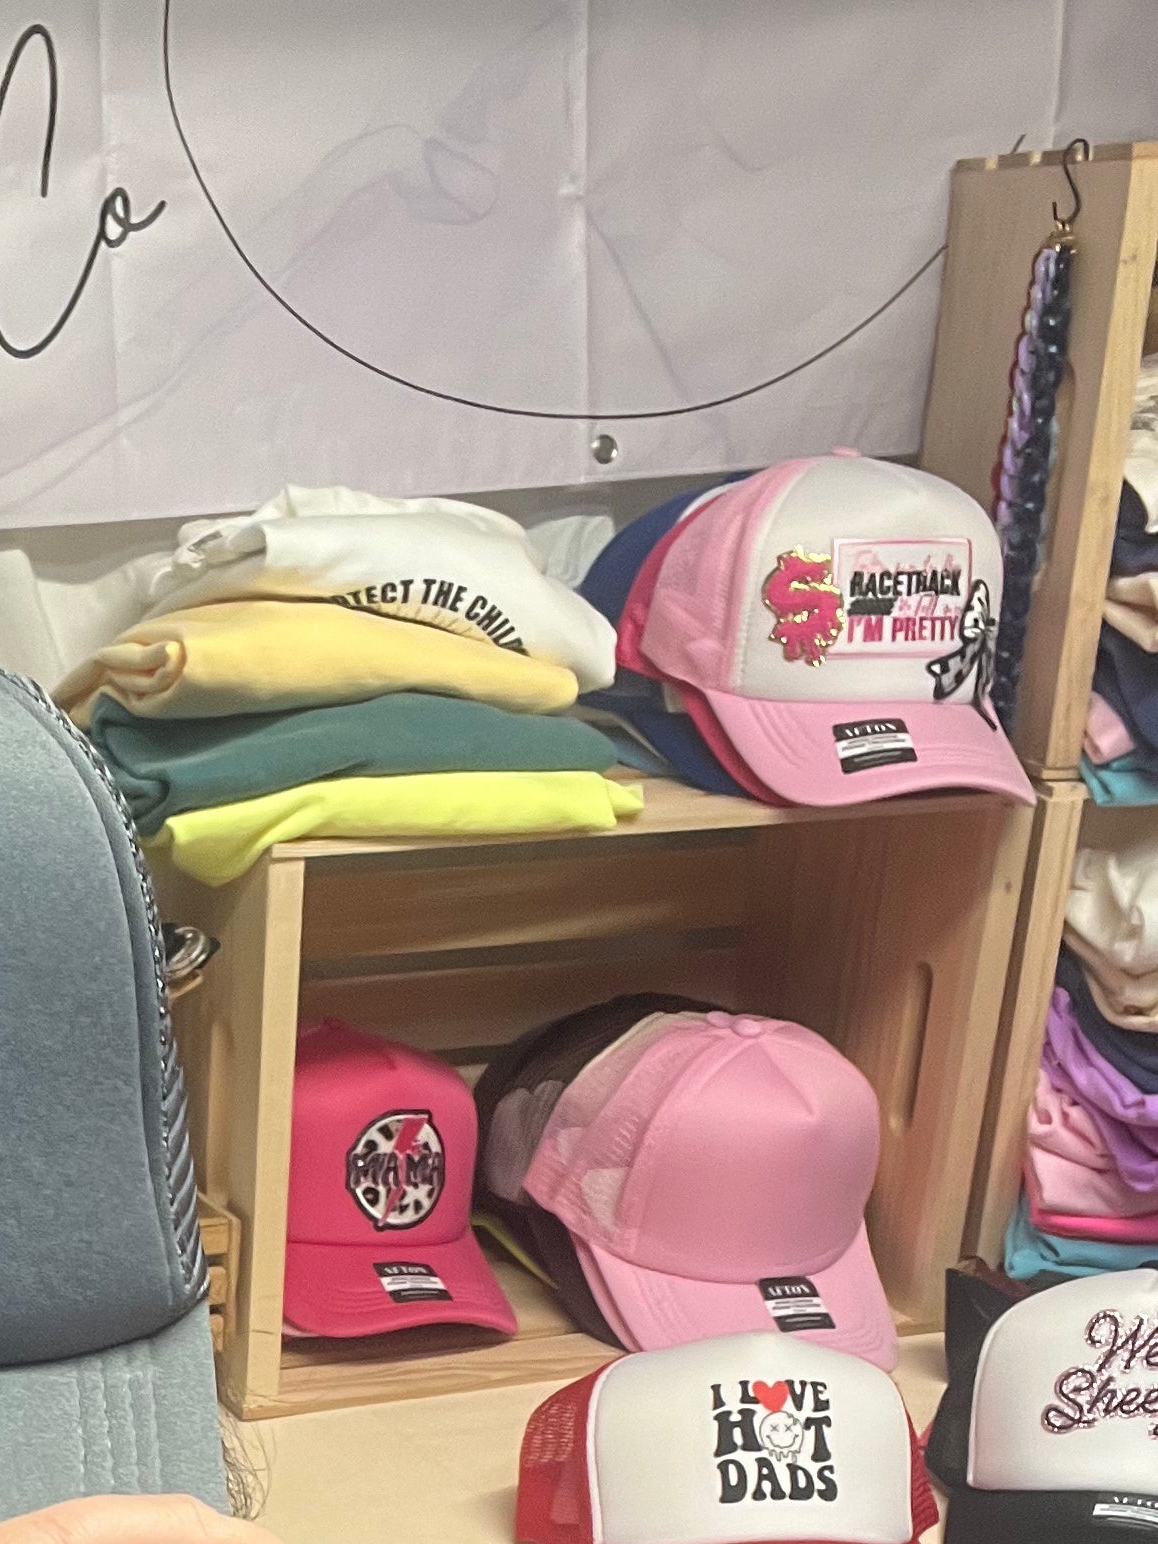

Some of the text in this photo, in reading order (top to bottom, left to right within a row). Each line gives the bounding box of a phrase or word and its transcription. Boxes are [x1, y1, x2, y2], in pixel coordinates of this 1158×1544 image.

[420, 578, 468, 613] THE
[847, 615, 959, 643] I'M PRETTY
[710, 1383, 726, 1411] I
[717, 1457, 838, 1504] DADS
